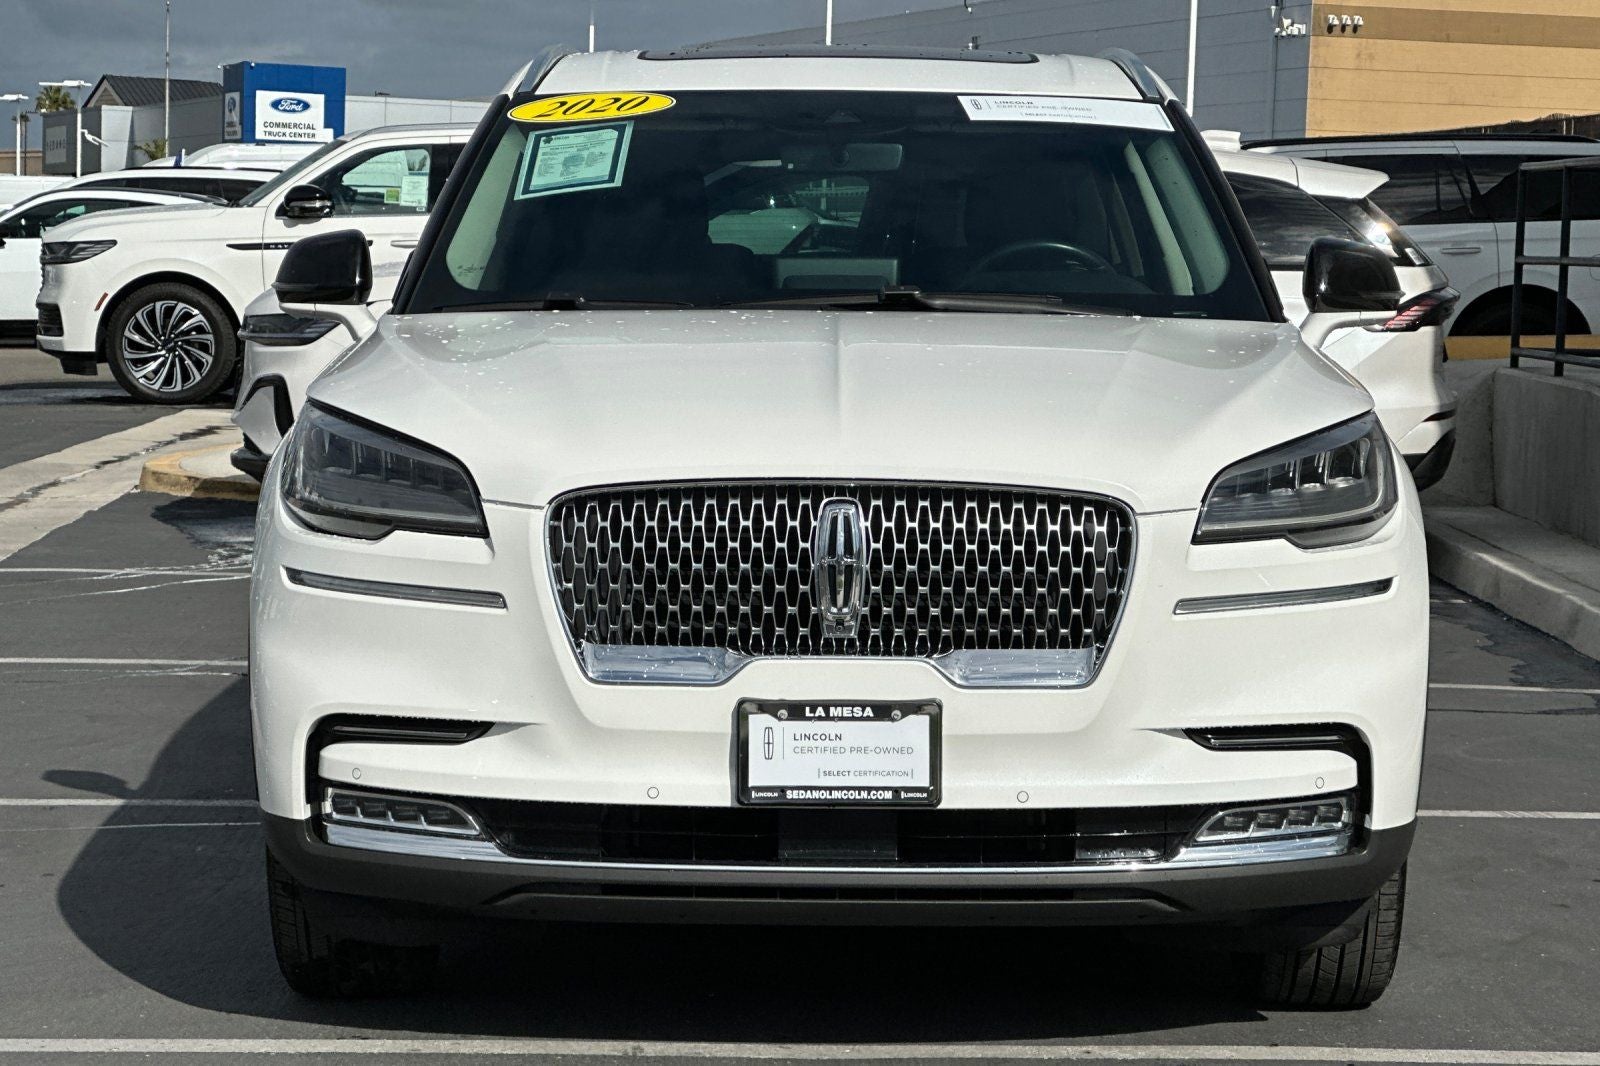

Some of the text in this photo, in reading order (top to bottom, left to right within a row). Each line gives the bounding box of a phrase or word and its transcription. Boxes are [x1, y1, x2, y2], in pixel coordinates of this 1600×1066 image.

[278, 99, 304, 111] Ford
[531, 96, 650, 118] 2020
[263, 121, 316, 130] COMMERCIAL
[263, 130, 316, 139] TRUCK CENTER
[805, 706, 874, 718] LA MESA
[793, 733, 843, 742] LINCOLN
[793, 746, 914, 755] CERTIFIED PRE-OWNED
[786, 790, 893, 800] SEDANOLINCOLN.COM
